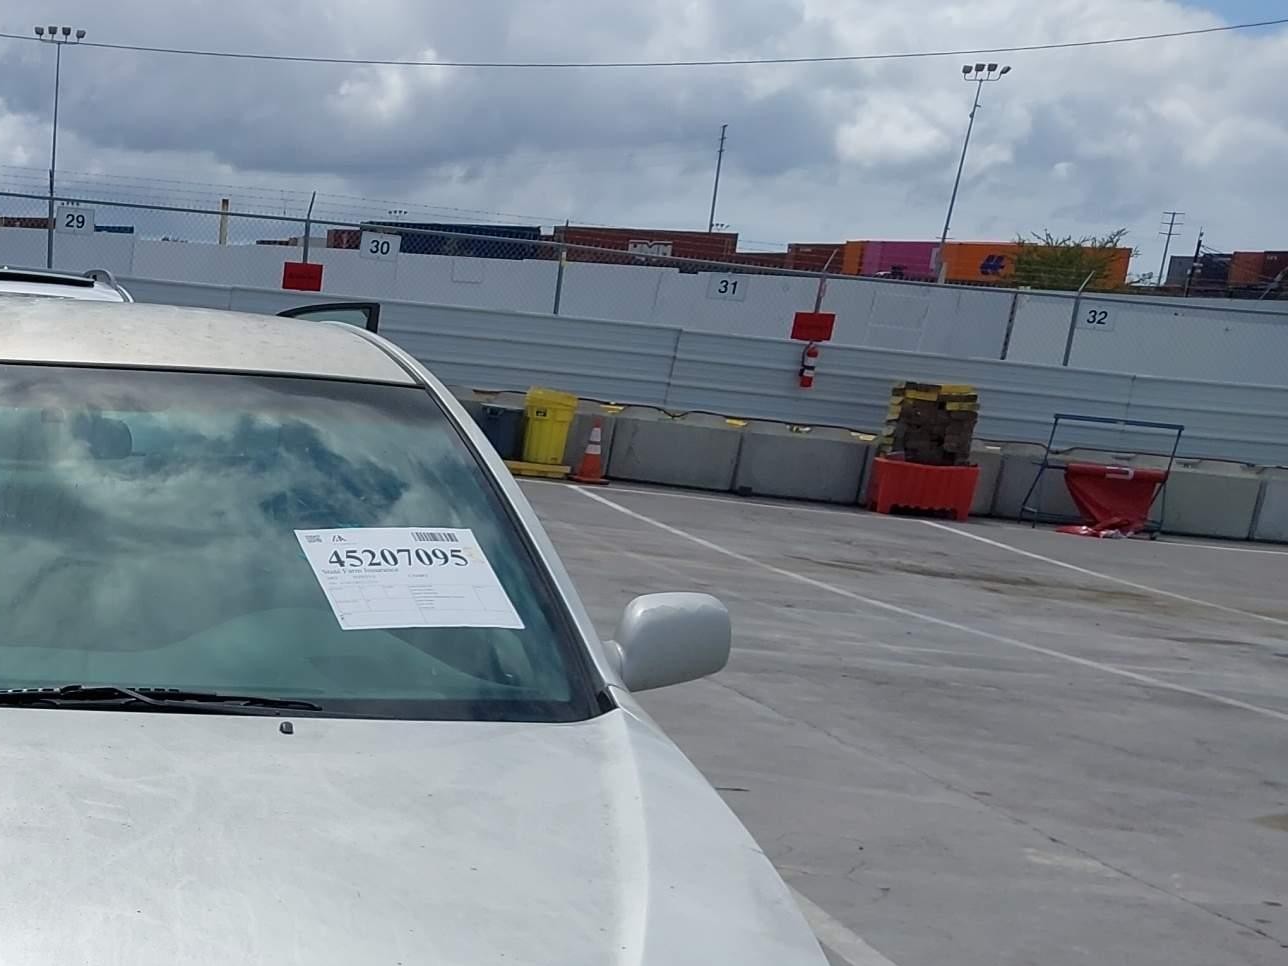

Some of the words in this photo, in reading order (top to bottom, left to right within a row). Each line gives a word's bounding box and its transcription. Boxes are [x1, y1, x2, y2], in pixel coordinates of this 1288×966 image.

[65, 213, 85, 229] 29
[369, 239, 390, 255] 30
[718, 279, 738, 295] 31
[1086, 309, 1108, 325] 32
[328, 547, 468, 567] 45207095
